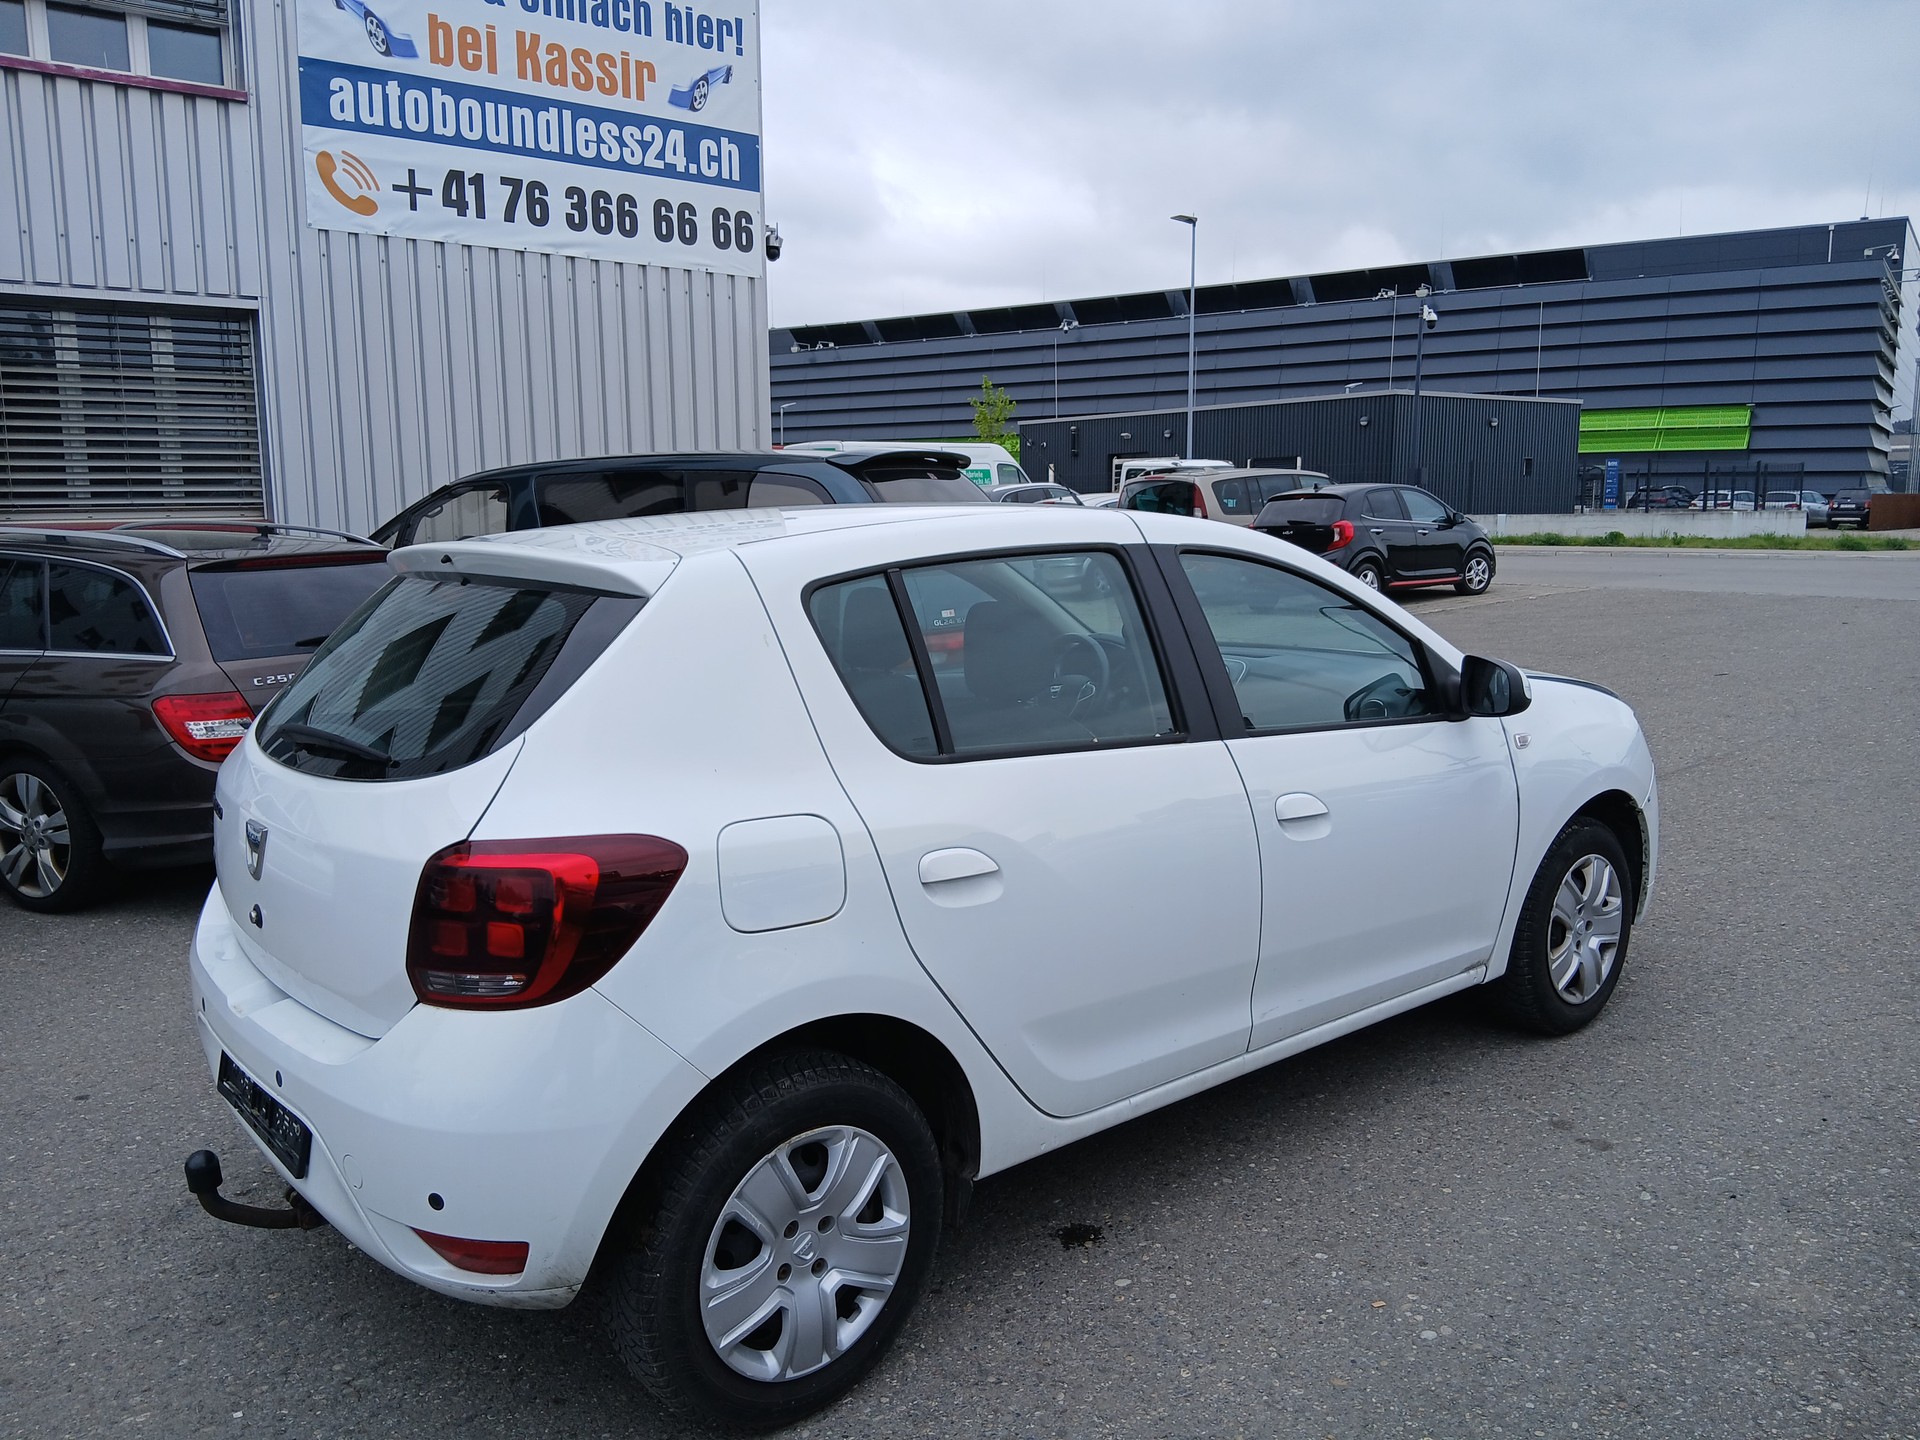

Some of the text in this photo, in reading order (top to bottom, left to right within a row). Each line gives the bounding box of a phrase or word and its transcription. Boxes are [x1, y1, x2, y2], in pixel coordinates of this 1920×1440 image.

[427, 13, 657, 102] bei Kassir
[665, 2, 744, 57] hier!
[329, 77, 741, 182] autoboundless24.ch
[392, 168, 754, 253] + 41 76 366 66 66
[253, 677, 264, 686] C
